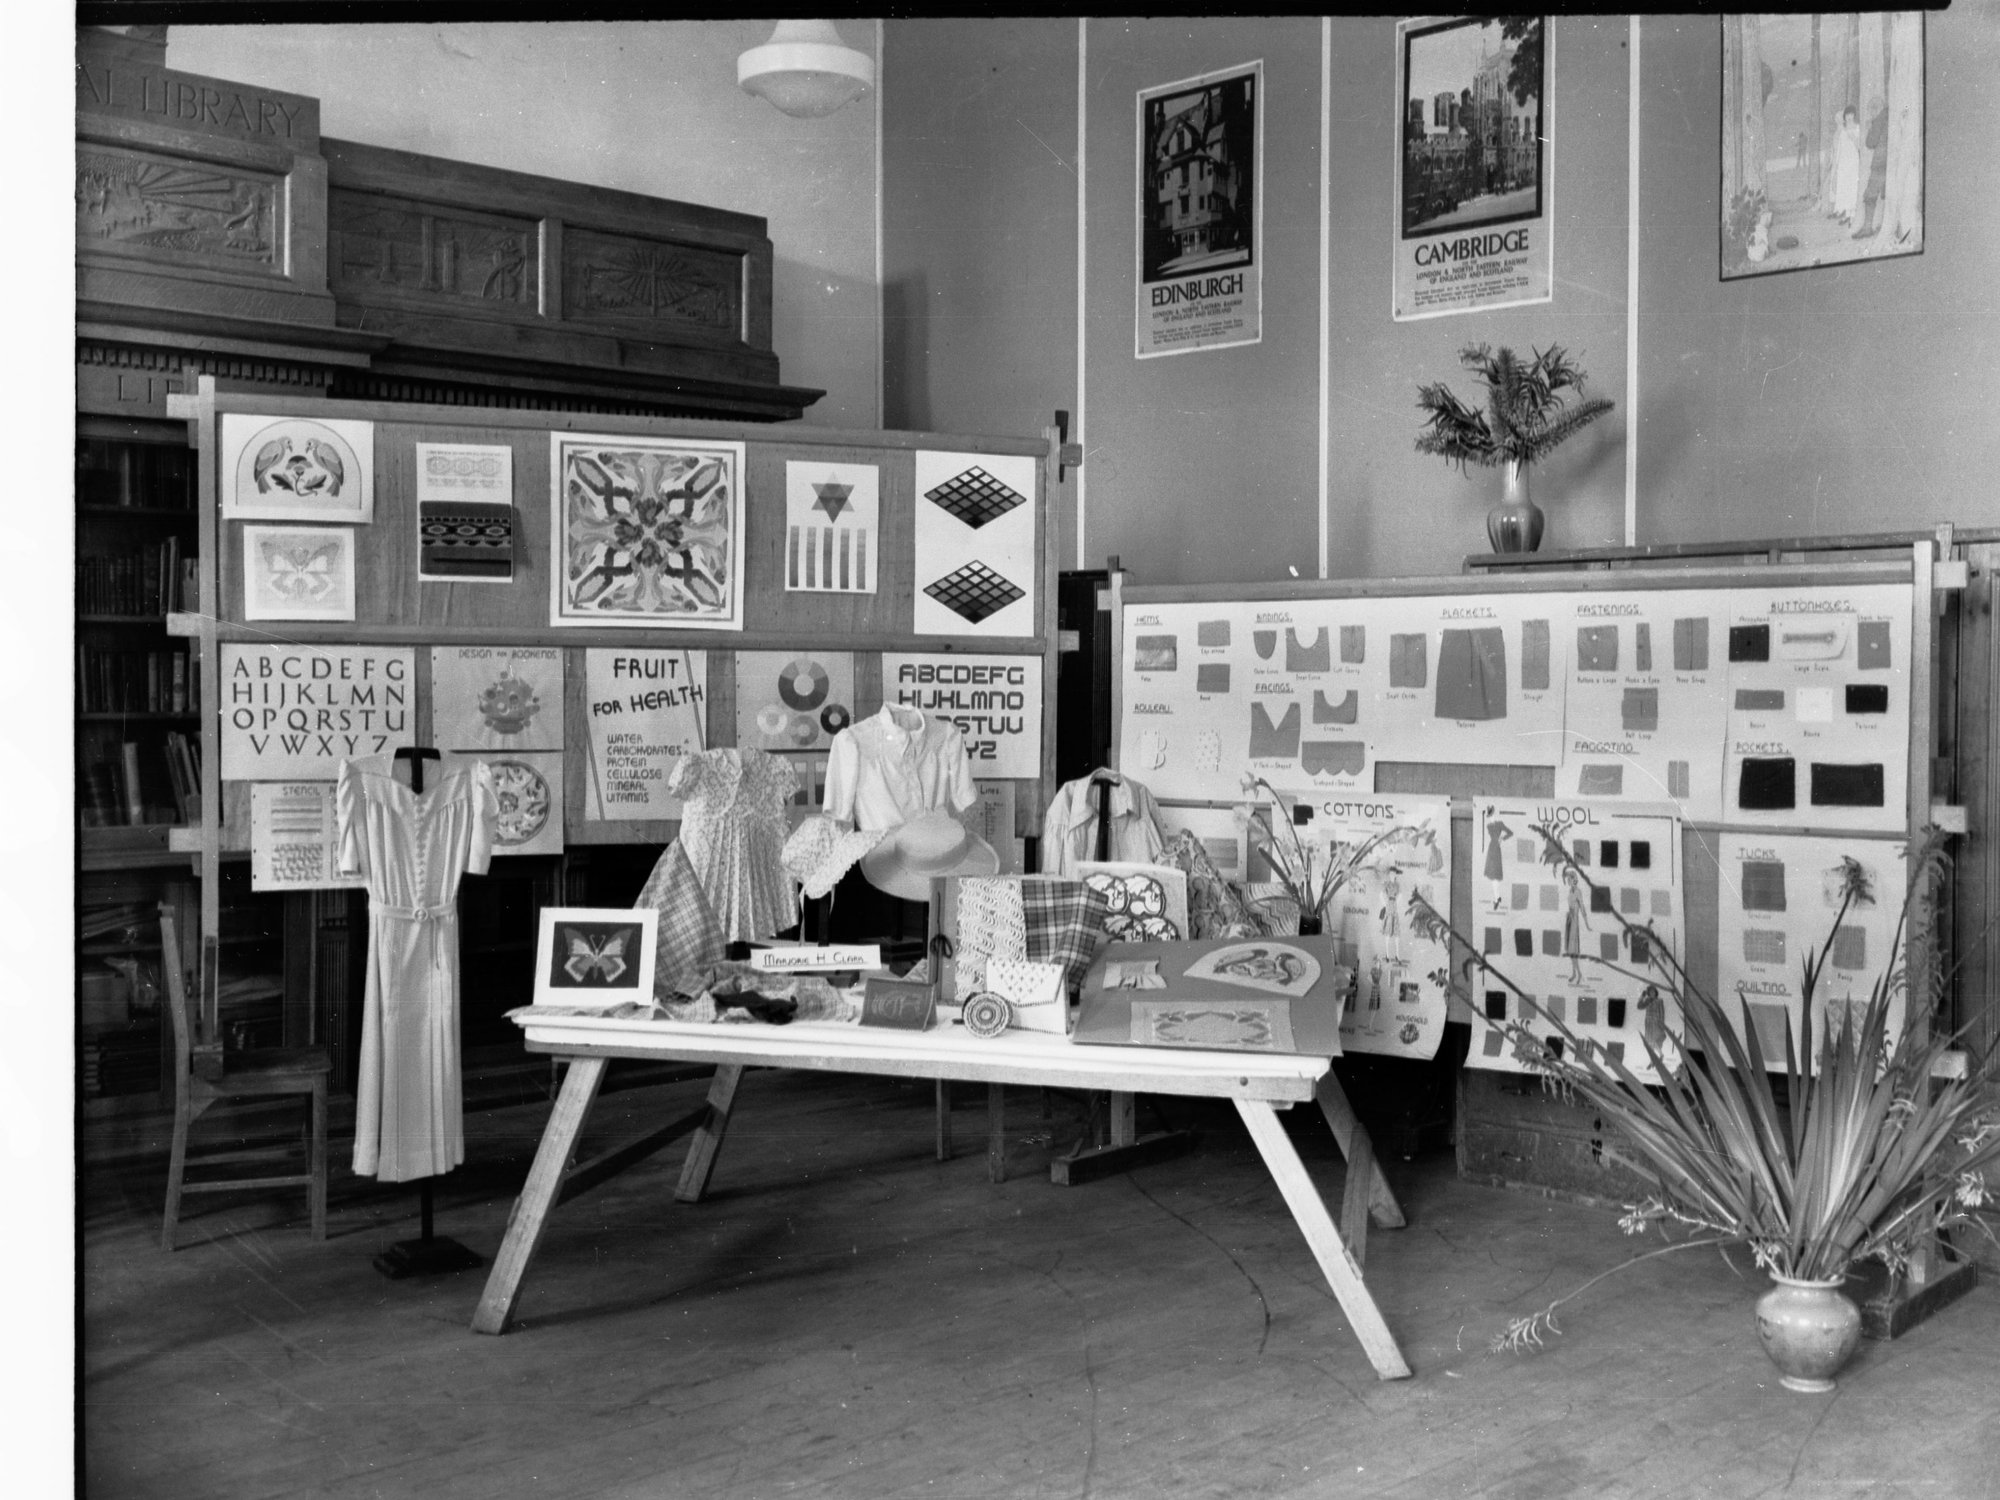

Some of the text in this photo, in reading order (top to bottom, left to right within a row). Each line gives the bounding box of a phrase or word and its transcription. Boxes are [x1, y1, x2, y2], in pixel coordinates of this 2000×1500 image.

[142, 76, 300, 137] LIBRARY
[1415, 228, 1529, 266] CAMBRIDGE
[1416, 270, 1441, 280] LONDON
[1452, 265, 1473, 273] NORTH
[1476, 261, 1501, 270] EASTERN
[1504, 257, 1528, 267] RAILWAY
[1439, 274, 1467, 283] ENGLAND
[1483, 266, 1513, 277] SCOTLAND
[1152, 273, 1243, 307] EDINBURGH
[459, 648, 492, 659] DESIGN
[613, 657, 679, 679] FRUIT
[899, 664, 1024, 685] ABCDEFG
[593, 684, 704, 717] FOR HEALTH
[607, 733, 643, 744] WATER
[607, 745, 682, 756] CARBOHYDRATES
[607, 757, 647, 768] PROTEIN
[607, 769, 662, 780] CELLULOSE
[282, 786, 320, 796] STENCIL
[607, 781, 647, 791] MINERAL
[606, 792, 649, 803] VITAMINS
[1323, 802, 1394, 819] COTTONS
[1537, 807, 1599, 825] WOOL
[816, 953, 825, 963] H
